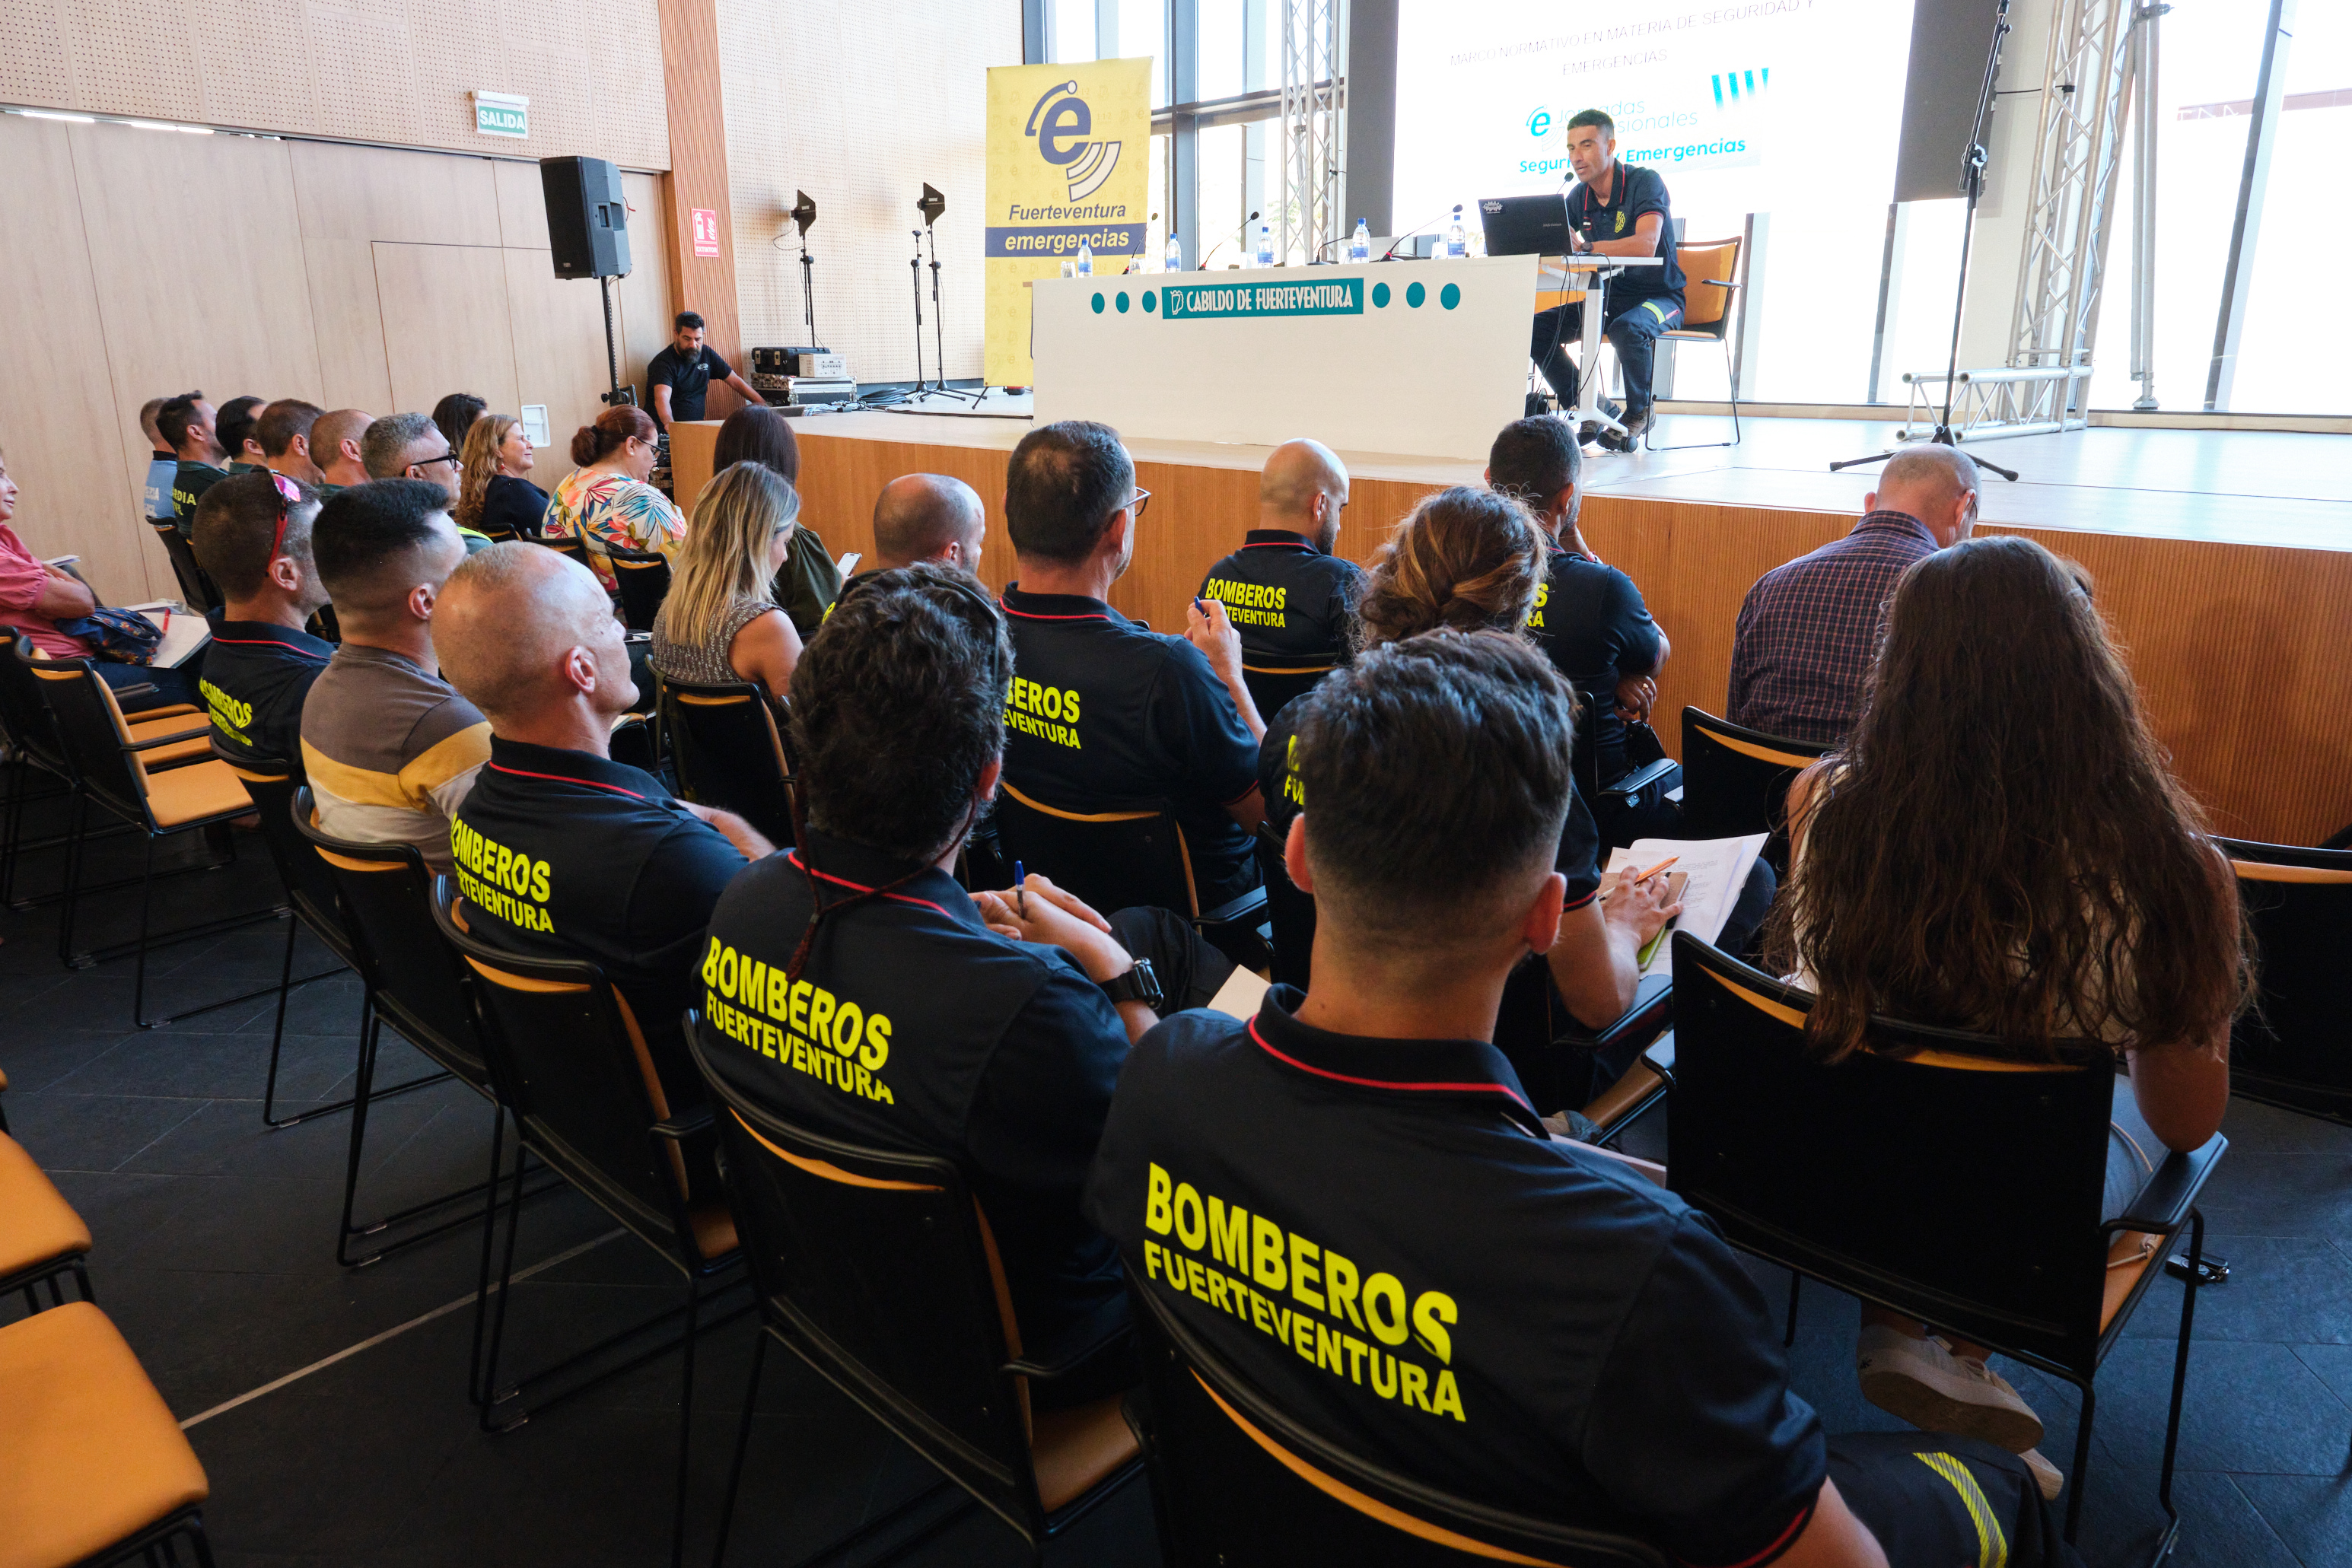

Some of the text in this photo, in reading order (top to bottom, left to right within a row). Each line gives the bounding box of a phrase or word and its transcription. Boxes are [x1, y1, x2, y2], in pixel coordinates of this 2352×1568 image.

[1450, 49, 1496, 66] MARCO
[1500, 34, 1580, 57] NORMATIVO
[1583, 31, 1602, 44] EN
[1607, 19, 1672, 40] MATERIA
[1677, 14, 1697, 30] DE
[1702, 0, 1800, 24] SEGURIDAD
[1563, 49, 1667, 75] EMERGENCIAS
[479, 110, 525, 130] SALIDA
[1626, 138, 1746, 162] Emergencias
[1008, 203, 1126, 221] Fuerteventura
[1186, 284, 1354, 313] CABILDO DE FUERTEVENTURA
[1205, 577, 1287, 610] BOMBEROS
[702, 935, 892, 1070] BOMBEROS
[706, 989, 895, 1105] FUERTEVENTURA
[1145, 1162, 1458, 1366] BOMBEROS
[1144, 1239, 1466, 1422] FUERTEVENTURA
